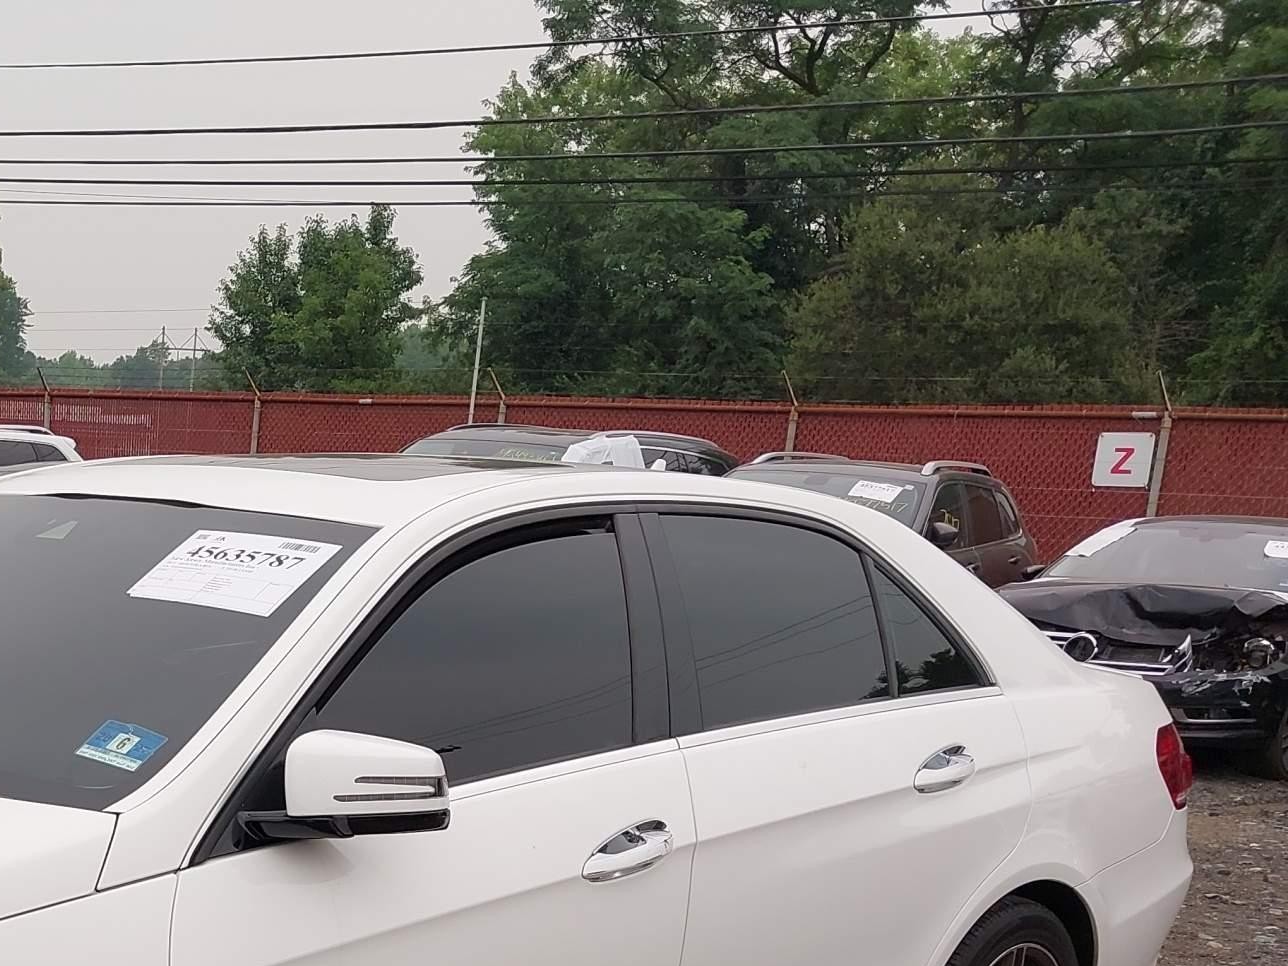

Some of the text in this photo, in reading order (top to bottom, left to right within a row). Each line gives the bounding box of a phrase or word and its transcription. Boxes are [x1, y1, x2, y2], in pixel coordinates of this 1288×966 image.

[1109, 447, 1136, 475] Z
[185, 544, 307, 570] 45635787
[115, 736, 131, 750] 6
